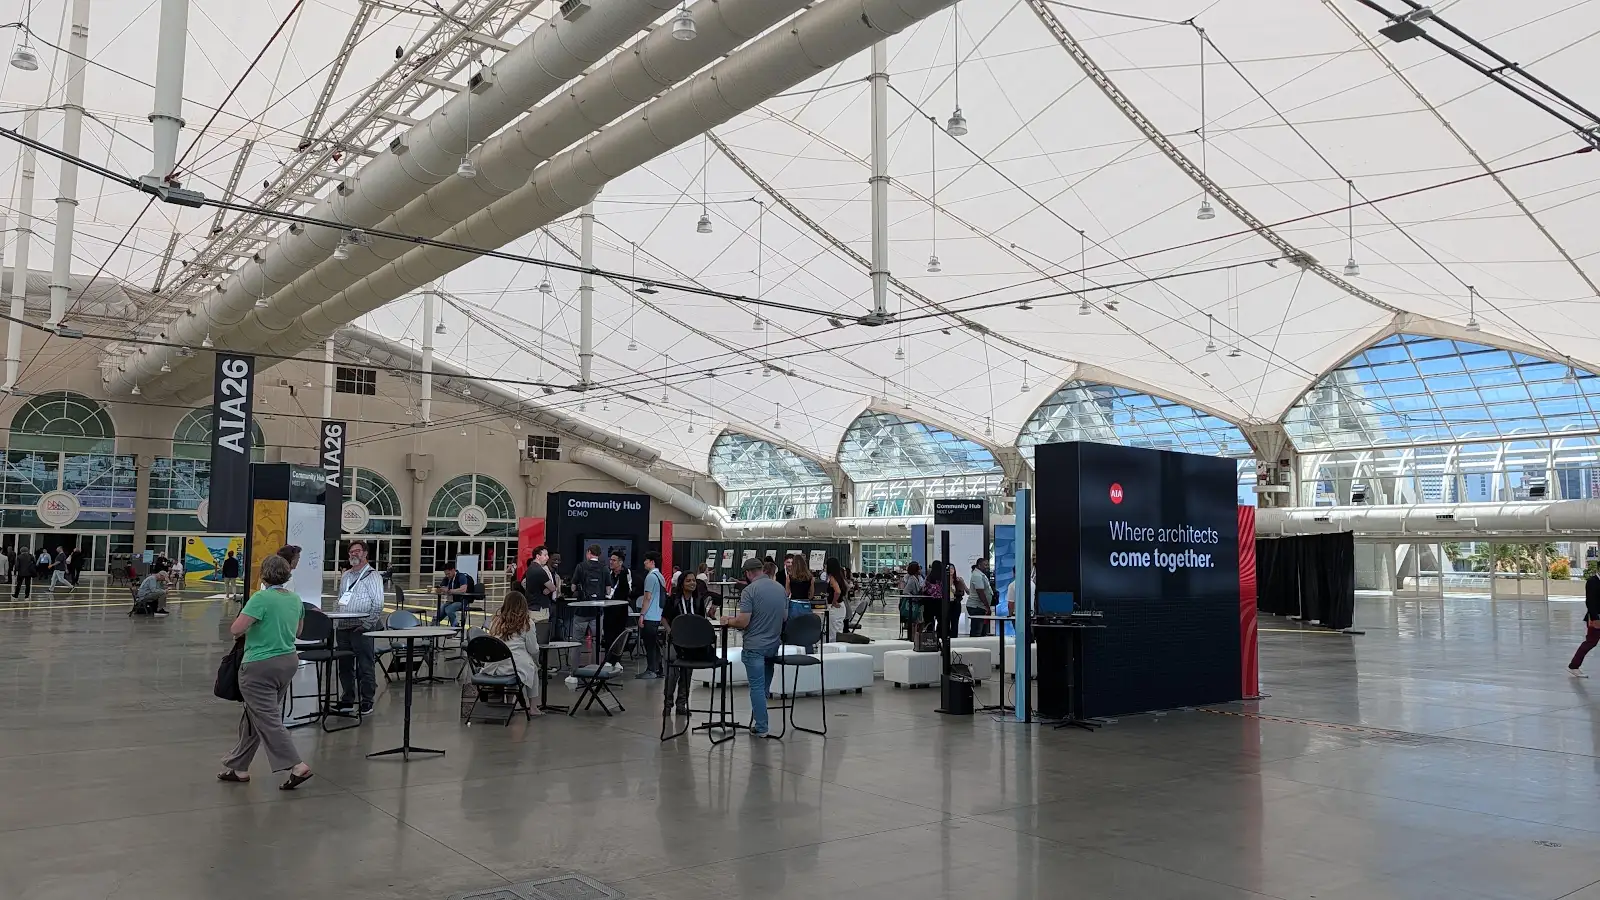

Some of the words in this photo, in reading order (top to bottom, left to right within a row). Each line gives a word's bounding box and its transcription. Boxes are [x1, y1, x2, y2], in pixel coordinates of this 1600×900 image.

[218, 358, 249, 454] AIA26
[323, 424, 343, 488] AIA26
[292, 471, 316, 482] Community
[316, 473, 325, 481] Hub
[1110, 489, 1122, 498] AIA
[567, 498, 621, 512] Community
[623, 500, 641, 510] Hub
[567, 509, 588, 517] DEMO
[1109, 520, 1155, 541] Where
[1158, 524, 1219, 544] architects
[1109, 551, 1150, 567] come
[1153, 548, 1215, 573] together.
